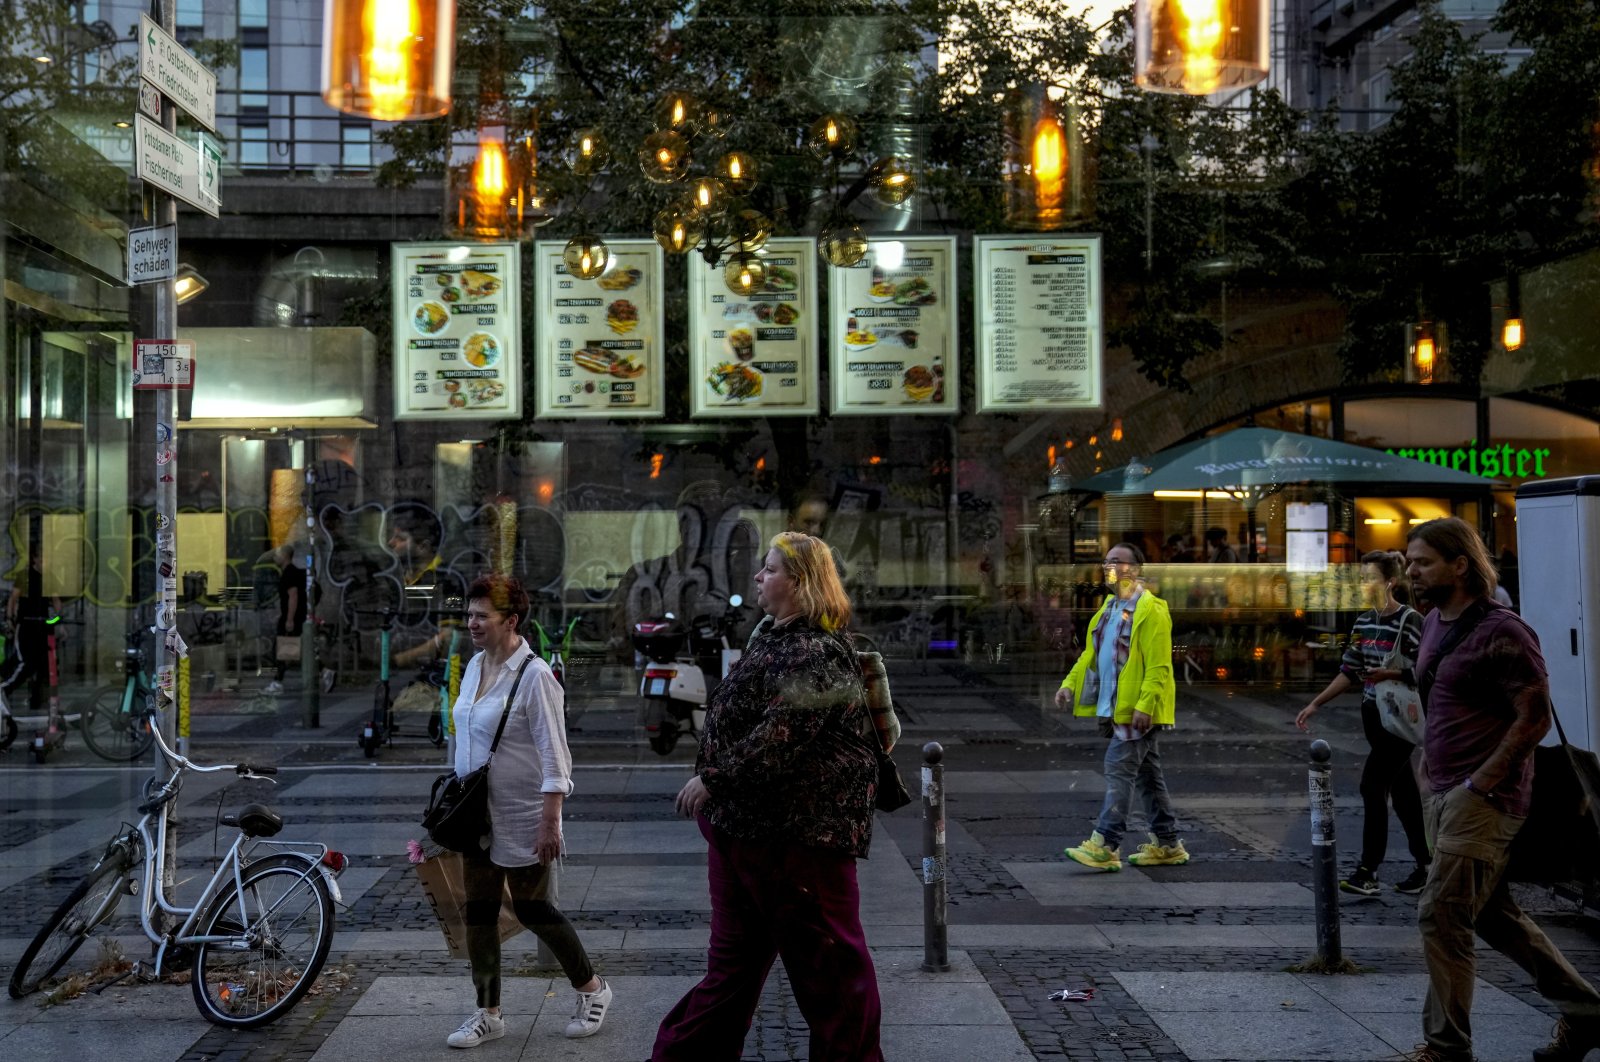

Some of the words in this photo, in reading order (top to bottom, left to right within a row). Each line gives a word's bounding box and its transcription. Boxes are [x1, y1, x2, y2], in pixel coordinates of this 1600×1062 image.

[167, 45, 199, 86] Ostbahnhof
[158, 64, 199, 110] Friedrichshain
[144, 127, 171, 157] Potsdamer
[171, 144, 184, 165] Platz
[145, 153, 183, 189] Fischerinsel
[134, 238, 172, 254] Gehweg-
[134, 252, 170, 275] schäden
[155, 345, 177, 356] 150
